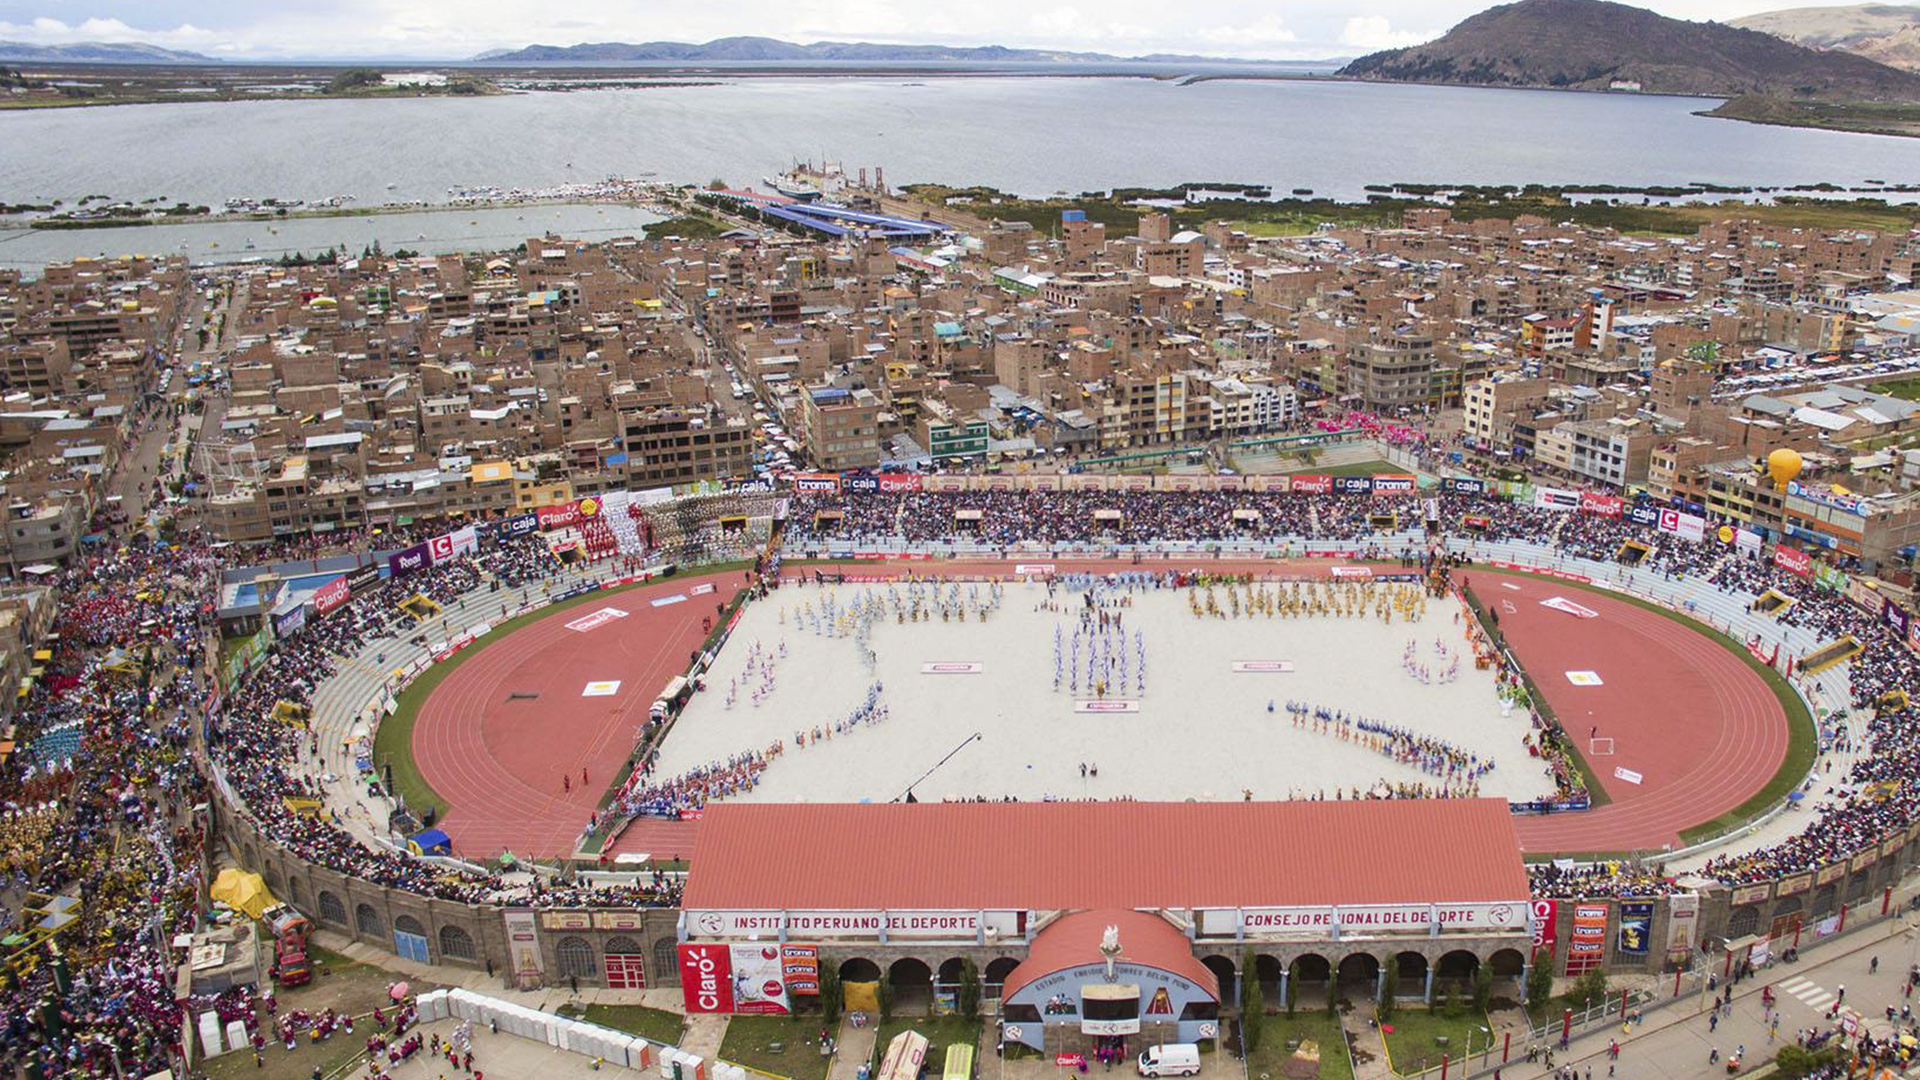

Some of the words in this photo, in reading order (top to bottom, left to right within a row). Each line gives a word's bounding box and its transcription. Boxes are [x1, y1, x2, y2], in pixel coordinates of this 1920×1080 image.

[799, 480, 835, 490] trome
[853, 478, 876, 489] caja
[881, 480, 912, 491] Claro
[1292, 480, 1324, 492] Claro
[1346, 478, 1369, 490] caja
[1376, 480, 1411, 490] trome
[1456, 482, 1480, 492] caja
[1583, 498, 1614, 514] Claro
[540, 512, 574, 526] Claro
[1633, 508, 1656, 521] caja
[512, 516, 536, 531] caja
[399, 552, 422, 569] Real
[1775, 552, 1802, 571] Claro
[316, 588, 344, 610] Claro
[814, 918, 879, 929] PERUANO
[912, 918, 976, 928] DEPORTE
[1245, 914, 1310, 926] CONSEJO
[1314, 913, 1379, 925] REIONAL
[1383, 912, 1407, 924] DEL
[1411, 910, 1474, 922] DEORTE
[1533, 901, 1550, 947] Claro
[1576, 926, 1602, 936] trome
[785, 949, 813, 957] trome
[1574, 943, 1600, 952] trome
[786, 966, 814, 974] trome
[698, 958, 719, 1010] Claro
[1035, 976, 1066, 992] ESTADIO
[1074, 968, 1104, 978] ENRIQUE
[1115, 966, 1143, 976] TORRES
[1146, 971, 1169, 984] BELON
[1172, 979, 1190, 992] PUNO
[790, 982, 815, 990] rome
[1057, 1056, 1078, 1064] Claro
